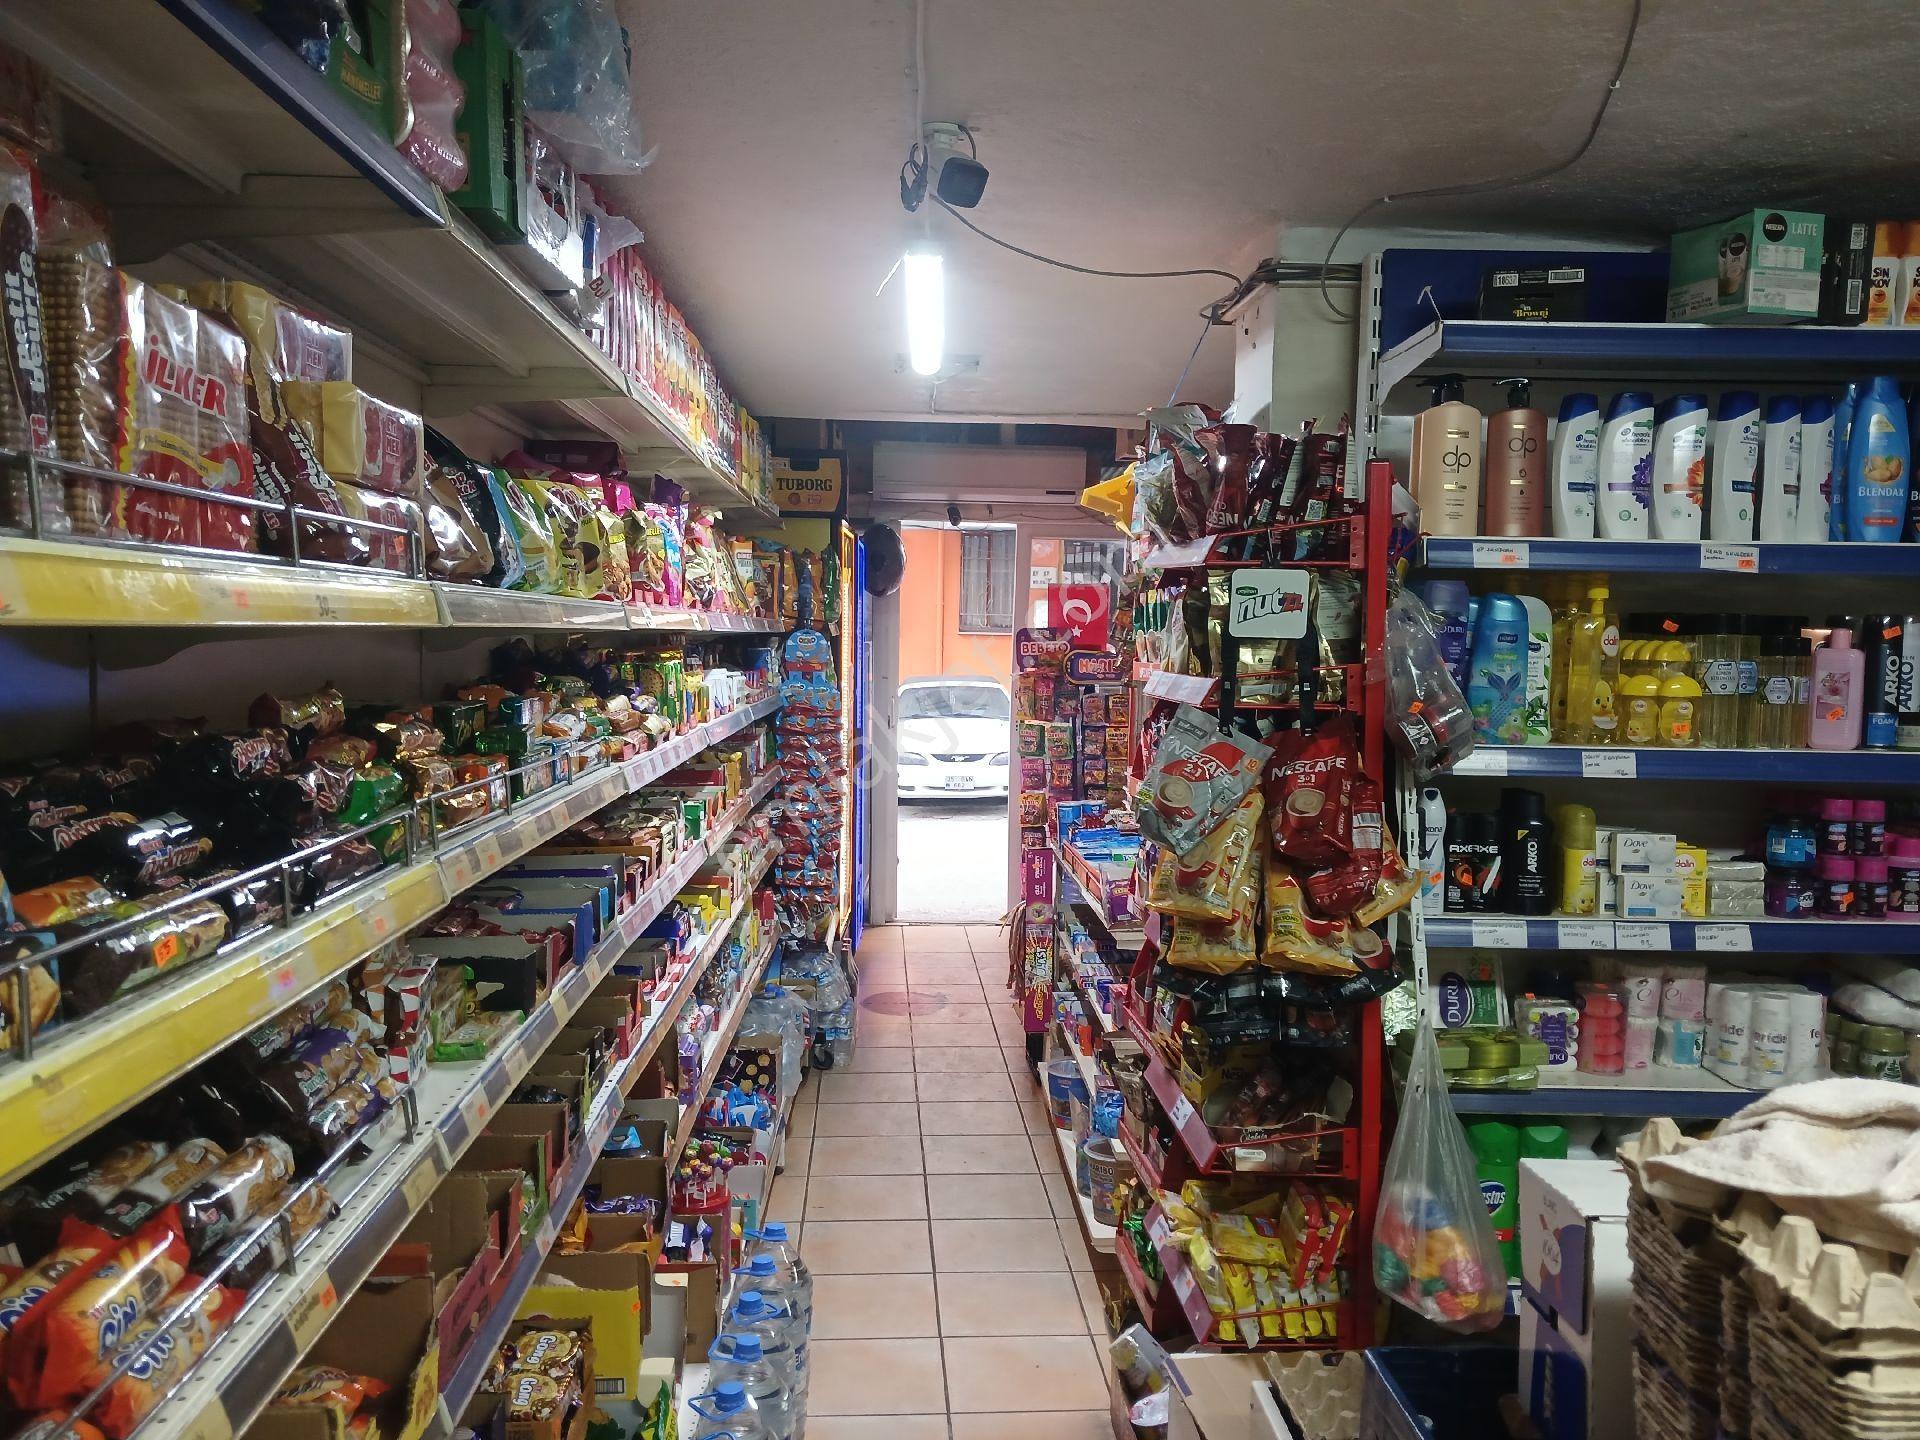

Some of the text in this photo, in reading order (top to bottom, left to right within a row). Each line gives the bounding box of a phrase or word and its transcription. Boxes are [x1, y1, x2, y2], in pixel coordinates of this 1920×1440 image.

[1792, 223, 1817, 236] LATTE
[1508, 430, 1537, 458] dp
[1442, 445, 1471, 473] dp
[776, 478, 833, 491] TUBORG
[1858, 485, 1904, 497] BLENDAX
[1021, 642, 1070, 655] BEBETO
[1885, 655, 1900, 706] ARKO
[1900, 661, 1914, 711] ARKO
[1473, 844, 1499, 853] AXE
[1624, 837, 1649, 848] Dove
[1527, 841, 1538, 873] ARKO
[1630, 880, 1655, 890] Dove
